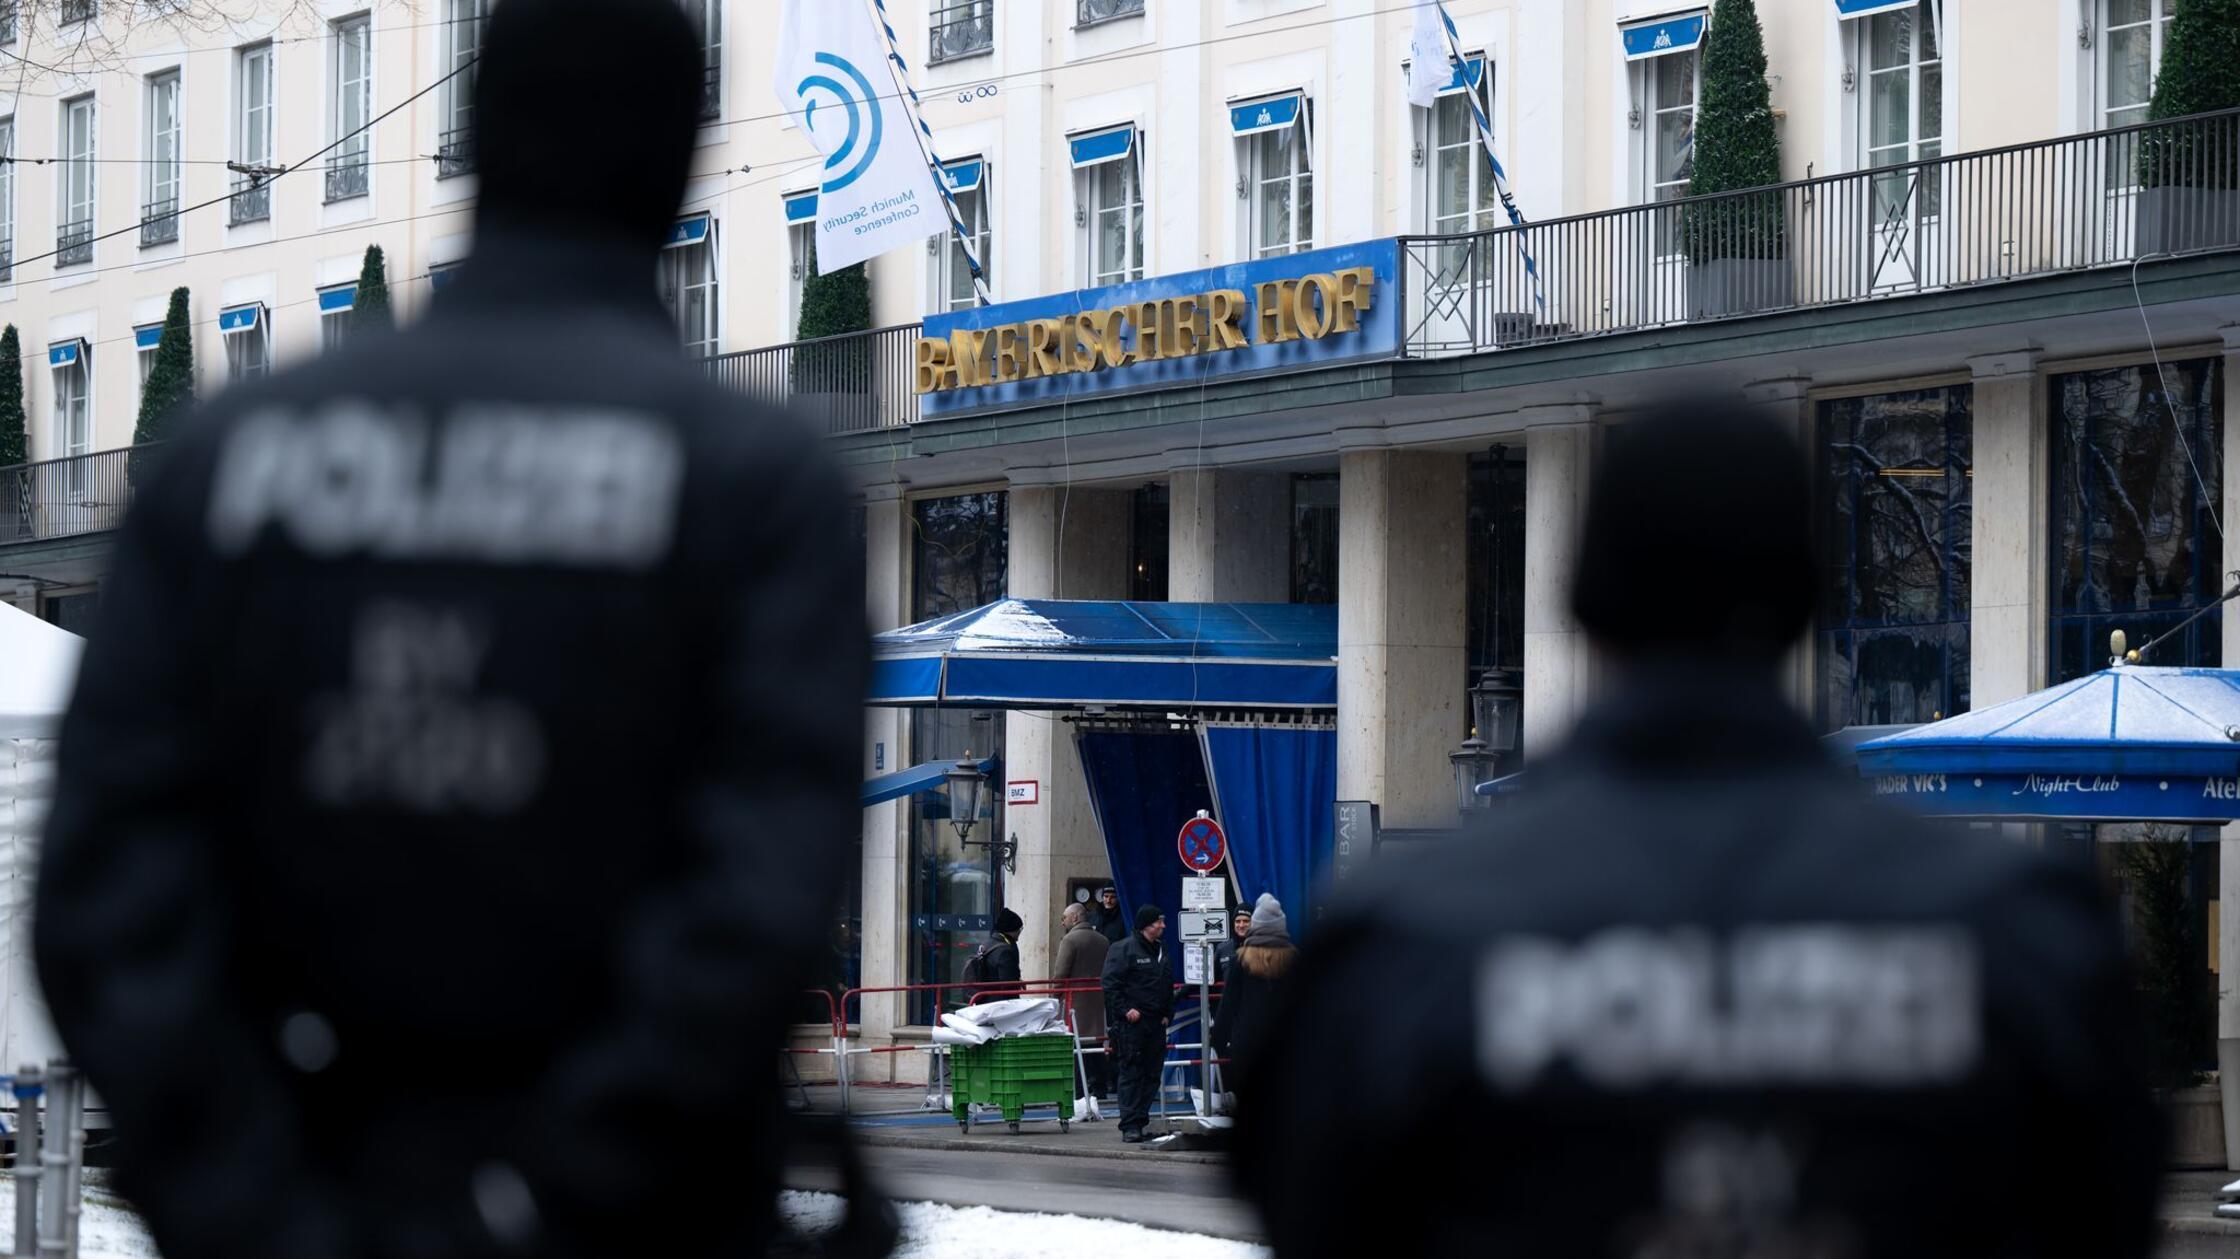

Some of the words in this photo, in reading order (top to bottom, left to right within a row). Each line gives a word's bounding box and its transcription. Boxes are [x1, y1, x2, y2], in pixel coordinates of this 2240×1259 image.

[913, 288, 1250, 395] BAYERISCHER
[1252, 265, 1375, 345] HOF
[1874, 775, 1908, 795] RADER
[1913, 774, 1947, 793] VIC'S
[1339, 806, 1350, 856] BAR
